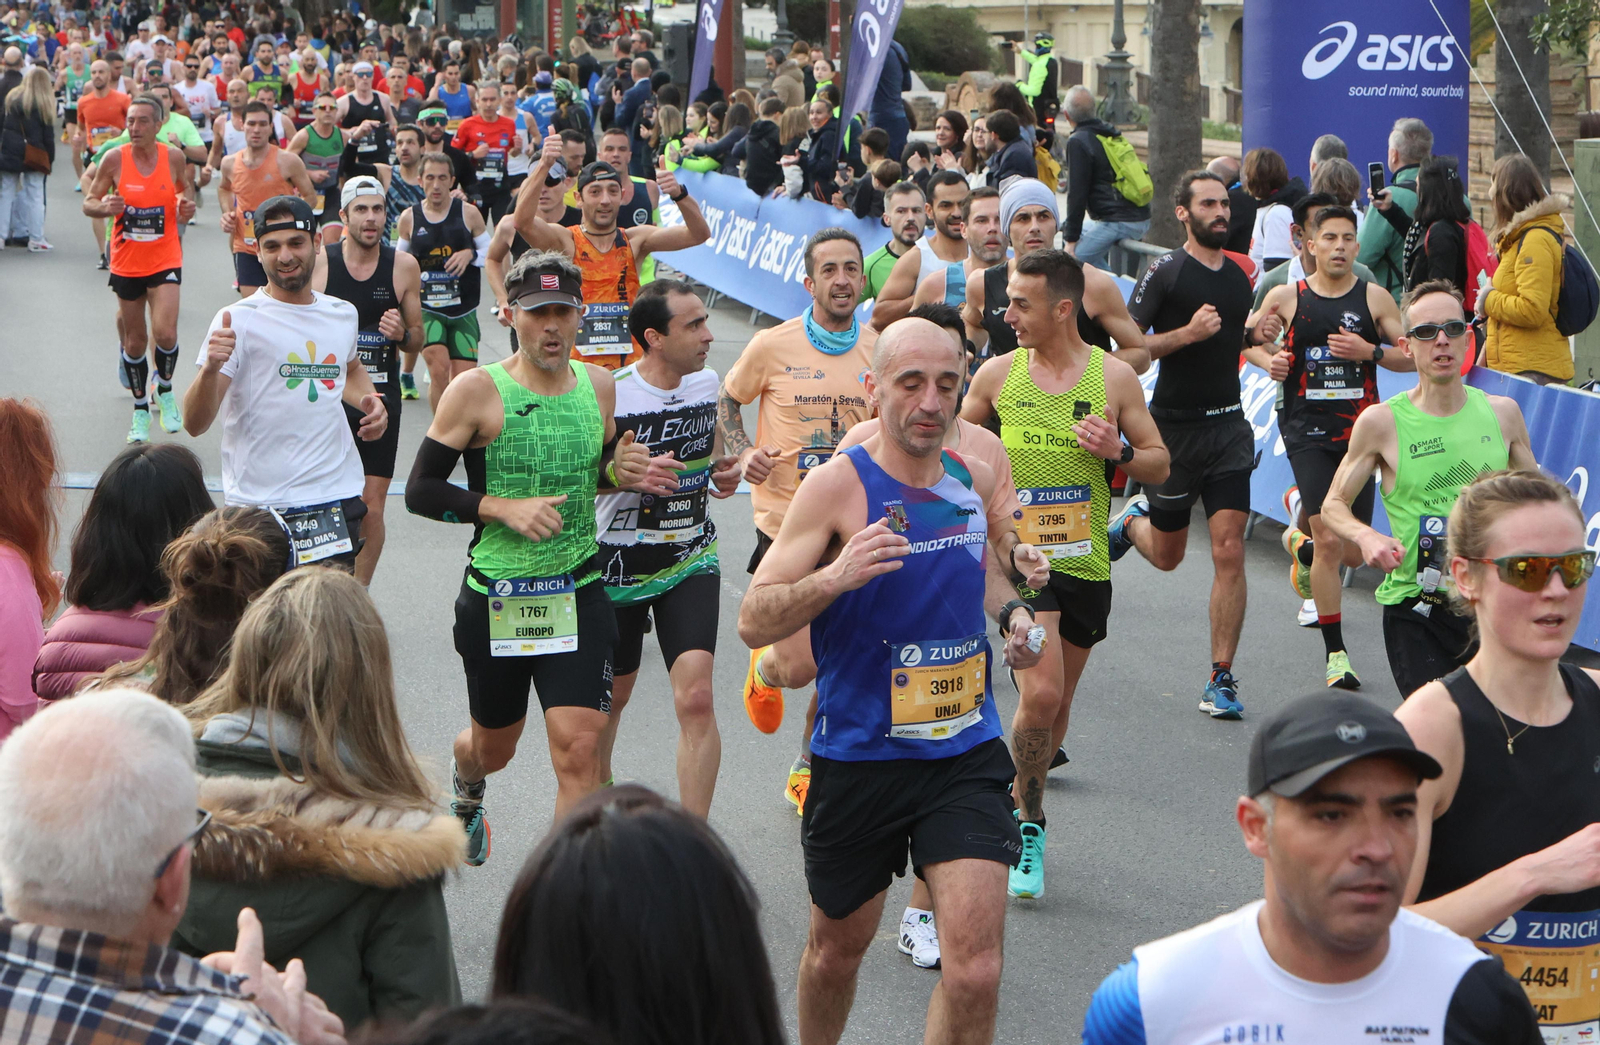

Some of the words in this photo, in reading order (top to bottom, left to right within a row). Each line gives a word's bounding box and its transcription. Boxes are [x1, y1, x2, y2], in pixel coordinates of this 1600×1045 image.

[1357, 34, 1455, 72] asics
[1348, 84, 1388, 97] sound
[1388, 84, 1418, 98] mind,
[1421, 85, 1450, 98] sound
[1450, 84, 1465, 99] body
[593, 304, 624, 313] ZURICH
[593, 322, 612, 331] 2837
[589, 335, 620, 344] MARIANO
[1324, 367, 1344, 376] 3346
[1324, 380, 1346, 388] PALMA
[794, 394, 832, 403] Maratón
[1023, 431, 1041, 444] Sa
[1417, 436, 1443, 448] SMART
[680, 434, 710, 459] CORRE
[1424, 442, 1444, 451] SPORT
[678, 473, 705, 488] URICH
[1037, 490, 1082, 502] ZURICH
[667, 499, 691, 513] 3060
[659, 517, 694, 529] MORUNO
[1038, 513, 1066, 526] 3795
[1039, 533, 1068, 543] TINTIN
[518, 579, 565, 592] ZURICH
[519, 605, 548, 618] 1767
[515, 626, 554, 637] EUROPO
[929, 638, 978, 661] ZURICH
[930, 676, 964, 696] 3918
[934, 702, 961, 719] UNAI
[1526, 919, 1598, 940] ZURICH
[1519, 966, 1569, 988] 4454
[1223, 1024, 1285, 1044] GOBIK
